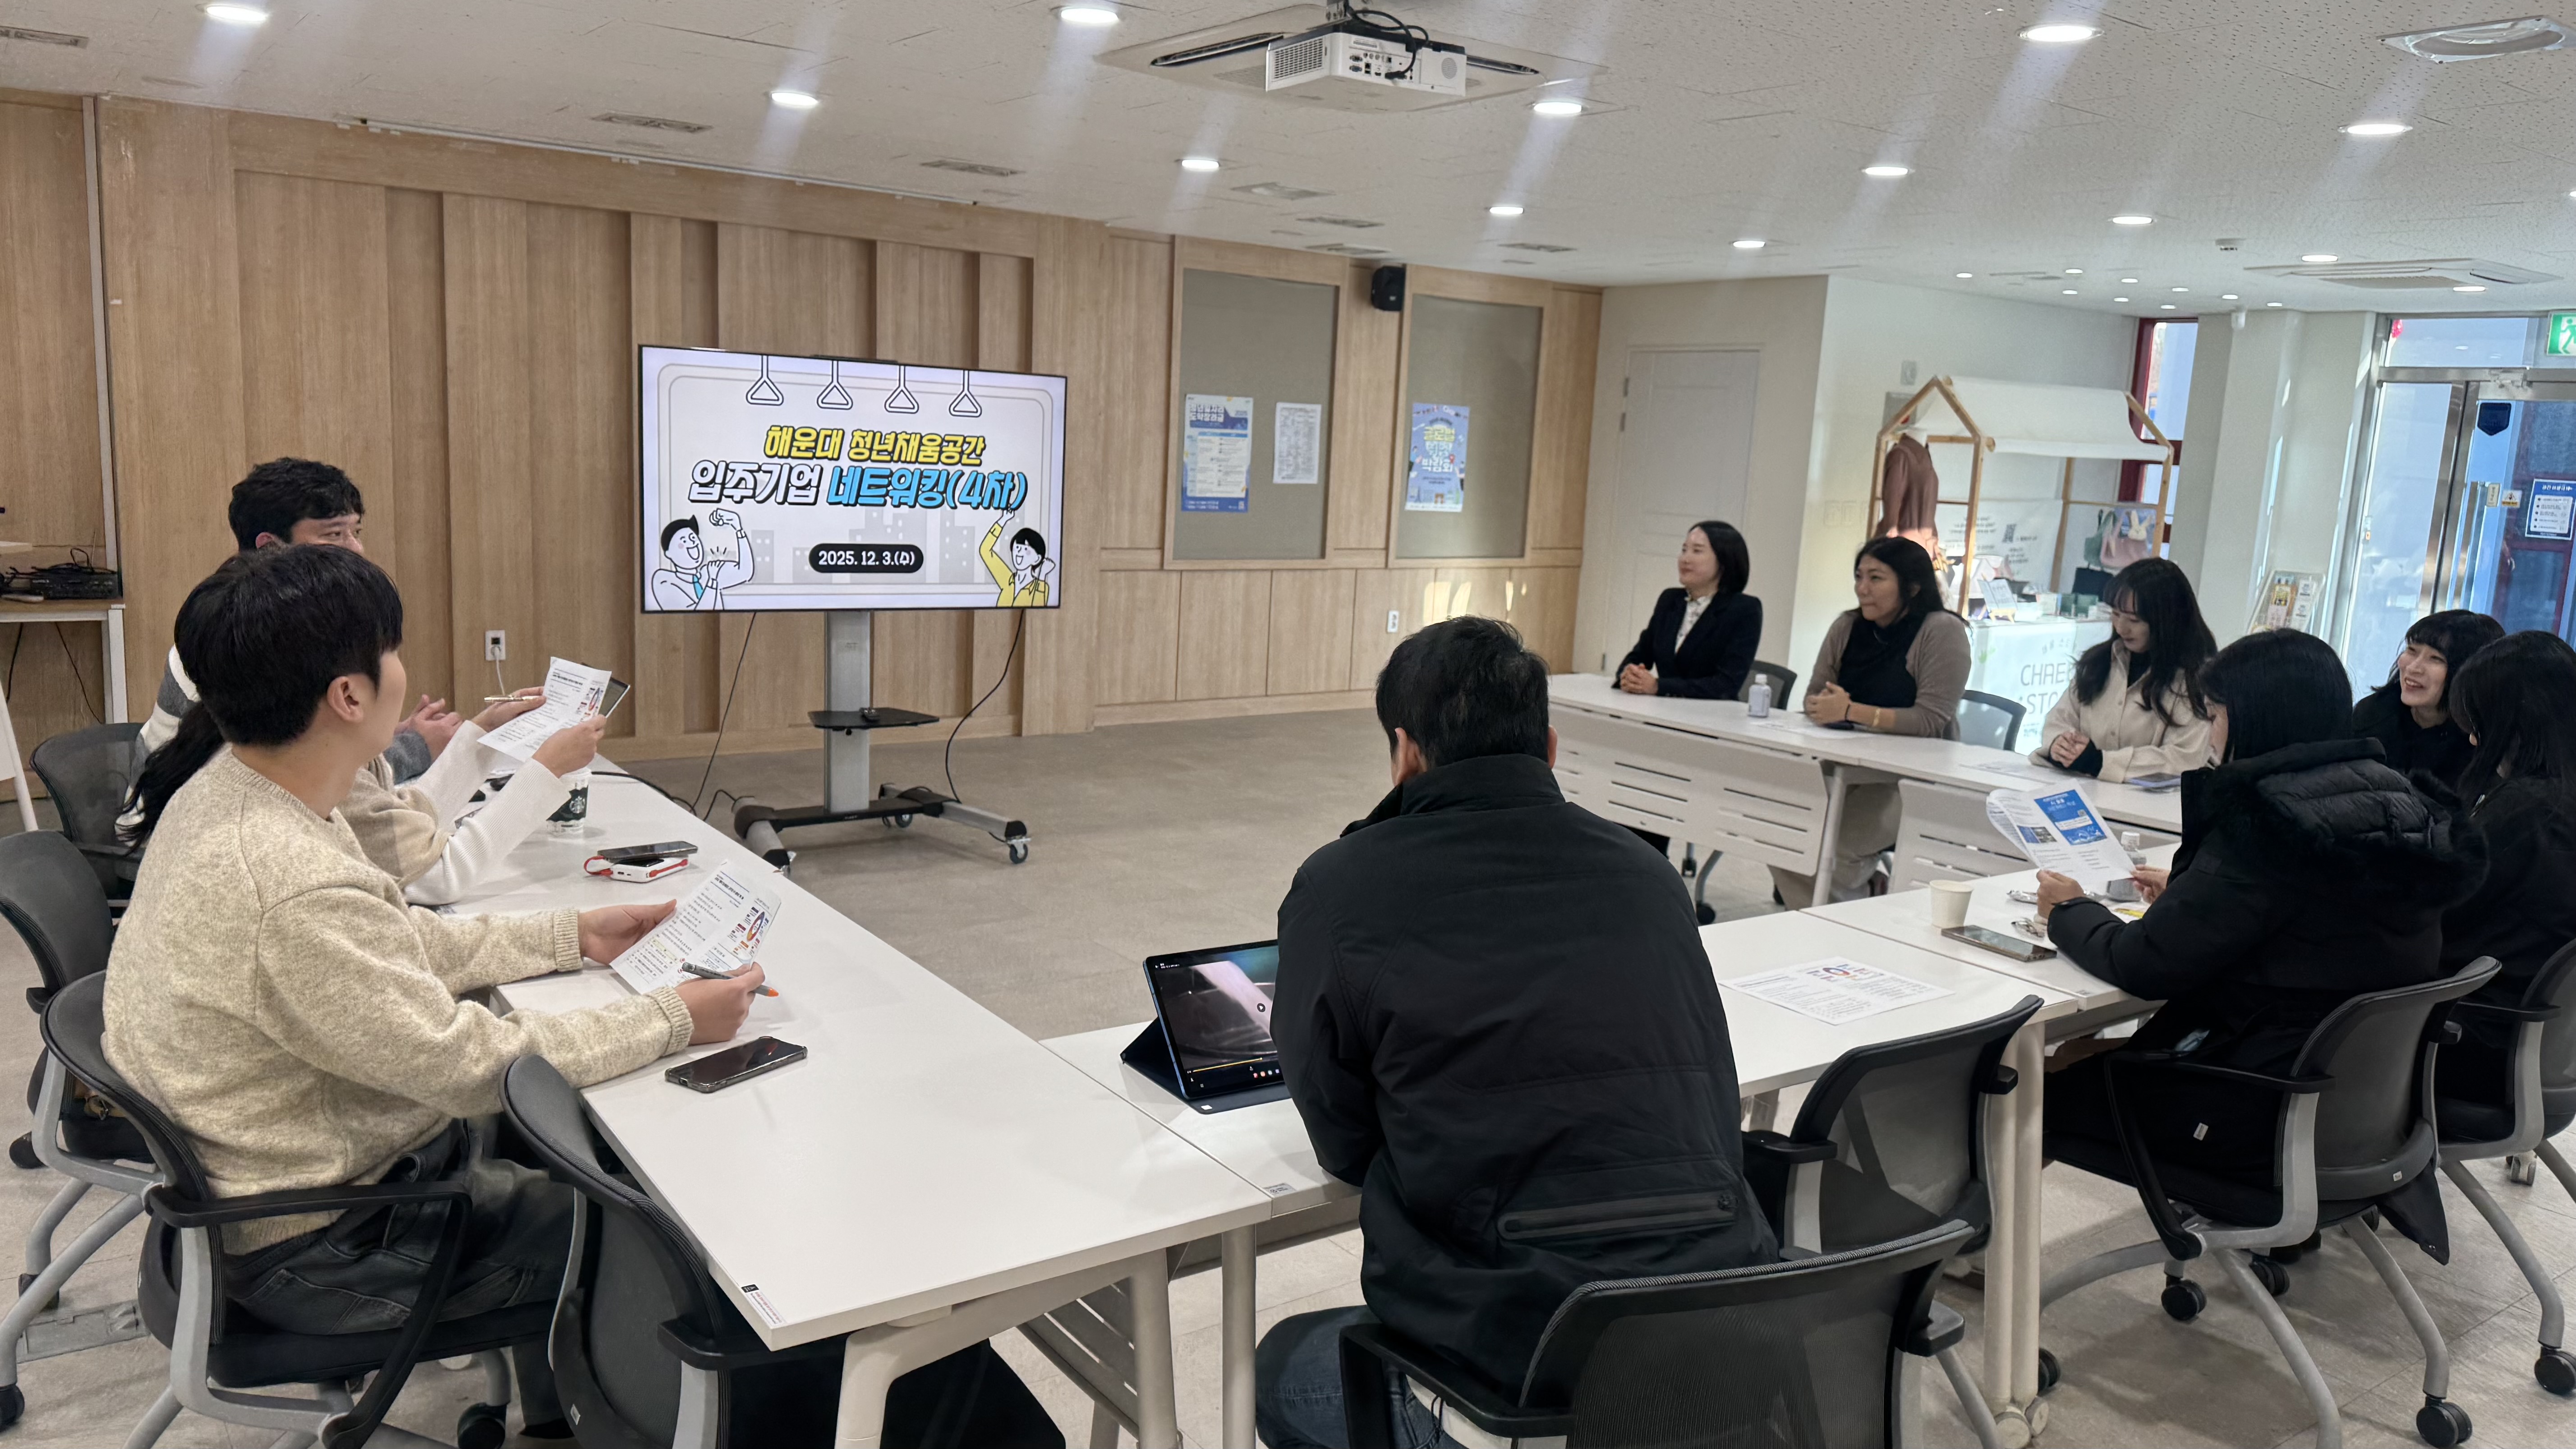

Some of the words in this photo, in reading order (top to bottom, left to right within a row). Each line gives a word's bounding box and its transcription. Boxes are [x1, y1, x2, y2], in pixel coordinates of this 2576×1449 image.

[764, 425, 844, 461] 해운대
[848, 428, 986, 466] 청년채움공간
[1421, 455, 1454, 473] 박람회
[688, 459, 824, 506] 입주기업
[826, 465, 1028, 511] 네트워킹(4차)
[818, 550, 858, 566] 2025.
[861, 550, 879, 566] 12.
[882, 551, 915, 566] 3.(수)
[2020, 662, 2070, 686] CHAE
